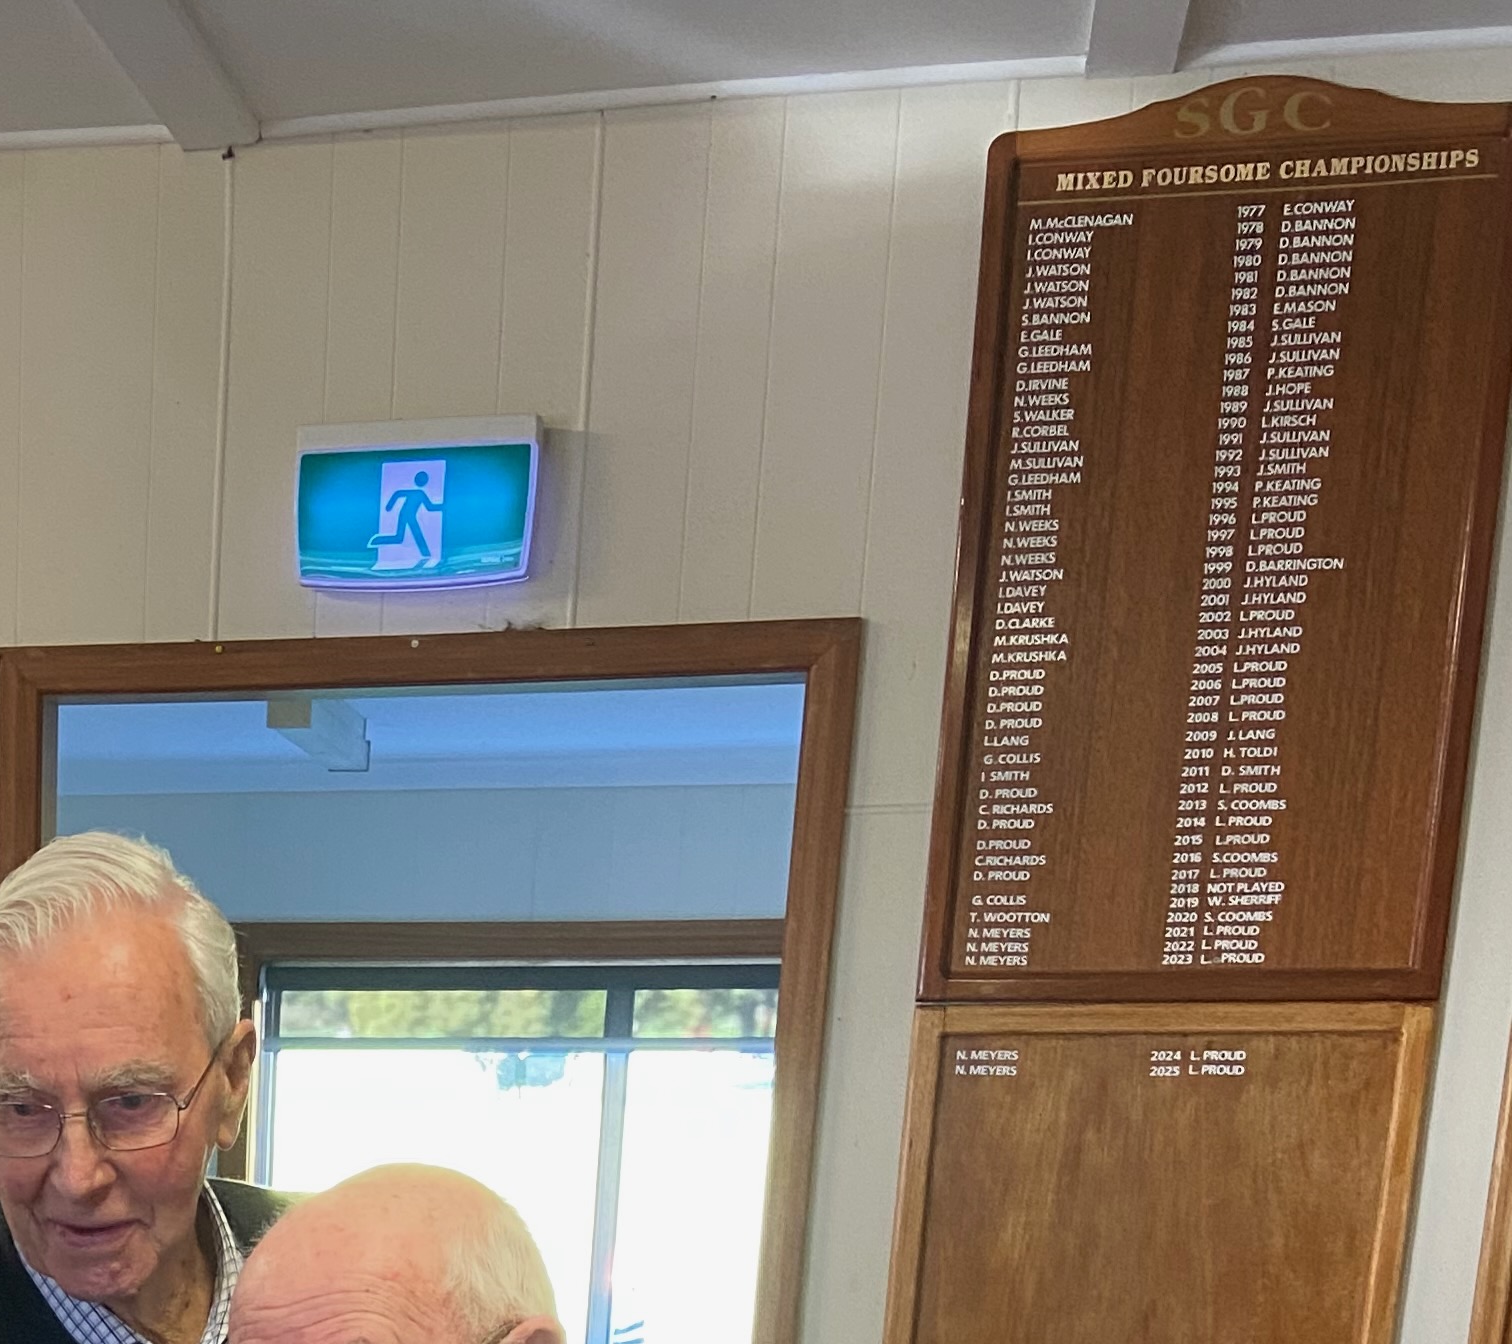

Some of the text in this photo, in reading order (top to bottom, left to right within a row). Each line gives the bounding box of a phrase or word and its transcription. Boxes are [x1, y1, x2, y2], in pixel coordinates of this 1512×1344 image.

[1174, 87, 1333, 138] SGC
[1055, 149, 1480, 192] MIXED FOURSOME CHAMPIONSHIPS
[1237, 204, 1266, 219] 1977
[1283, 199, 1355, 216] E.CONWAY
[1028, 216, 1356, 246] I.CONWAY 1978 D.BANNON
[1026, 233, 1355, 261] I.CONWAY 1979 D.BANNON
[1025, 249, 1353, 278] J.WATSON 1980 D.BANNON
[1023, 265, 1352, 295] J.WATSON 1981 D.BANNON
[1022, 281, 1350, 310] J.WATSON 1982 D.BANNON
[1021, 299, 1337, 327] S.BANNON 1983 E.MASON
[1020, 316, 1316, 343] E.GALE 1984 S.GALE
[1017, 331, 1342, 358] G.LEEDHAM 1985 J.SULLIVAN
[1016, 347, 1341, 374] G.LEEDHAM 1986 J.SULLIVAN
[1015, 364, 1335, 393] D.IRVINE 1987 P.KEATING
[1013, 381, 1312, 408] N.WEEKS 1988 J.HOPE
[1012, 397, 1334, 424] S.WALKER 1989 J.SULLIVAN
[1011, 413, 1317, 439] R.CORBEL 1990 L.KIRSCH
[1010, 429, 1331, 454] J.SULLIVAN 1991 J.SULLIVAN
[1009, 445, 1330, 471] M.SULLIVAN 1992 J.SULLIVAN
[1007, 462, 1307, 487] G.LEEDHAM 1993 J.SMITH
[1006, 477, 1322, 502] I.SMITH 1994 P.KEATING
[1005, 493, 1319, 517] I.SMITH 1995 P.KEATING
[1004, 509, 1307, 533] N.WEEKS 1996 L.PROUD
[1002, 526, 1305, 549] N.WEEKS 1997 L.PROUD
[1000, 542, 1304, 567] N.WEEKS 1998 L.PROUD
[998, 557, 1345, 583] J.WATSON 1999 D.BARRINGTON
[998, 574, 1309, 599] I.DAVEY 2000 J.HYLAND
[996, 591, 1307, 615] I.DAVEY 2001 J.HYLAND
[995, 609, 1296, 631] D.CLARKE 2002 L.PROUD
[1197, 628, 1230, 641] 2003
[1237, 625, 1303, 639] J.HYLAND
[1194, 644, 1227, 657] 2004
[1235, 642, 1301, 656] J.HYLAND
[989, 660, 1288, 681] D.PROUD 2005 L.PROUD
[988, 676, 1287, 698] D.PROUD 2006 L.PROUD
[986, 692, 1285, 714] D.PROUD 2007 L.PROUD
[976, 833, 1271, 851] D.PROUD 2015 L.PROUD
[974, 851, 1279, 867] C.RICHARDS 2016 S.COOMBS
[983, 912, 1051, 923] WOOTTON
[1166, 911, 1198, 923] 2020
[1217, 910, 1273, 923] COOMBS
[982, 927, 1031, 939] MEYERS
[1164, 926, 1195, 938] 2021
[1215, 925, 1260, 936] PROUD
[980, 942, 1029, 953] MEYERS
[1163, 940, 1195, 952] 2022
[1213, 939, 1259, 951] PROUD
[979, 955, 1028, 966] MEYERS
[1161, 953, 1193, 966] 2023
[1220, 952, 1266, 964] PROUD
[970, 1050, 1019, 1061] MEYERS
[1149, 1050, 1182, 1061] 2024
[1202, 1050, 1247, 1061] PROUD
[969, 1065, 1017, 1076] MEYERS
[1148, 1066, 1180, 1077] 2025
[1200, 1065, 1245, 1076] PROUD
